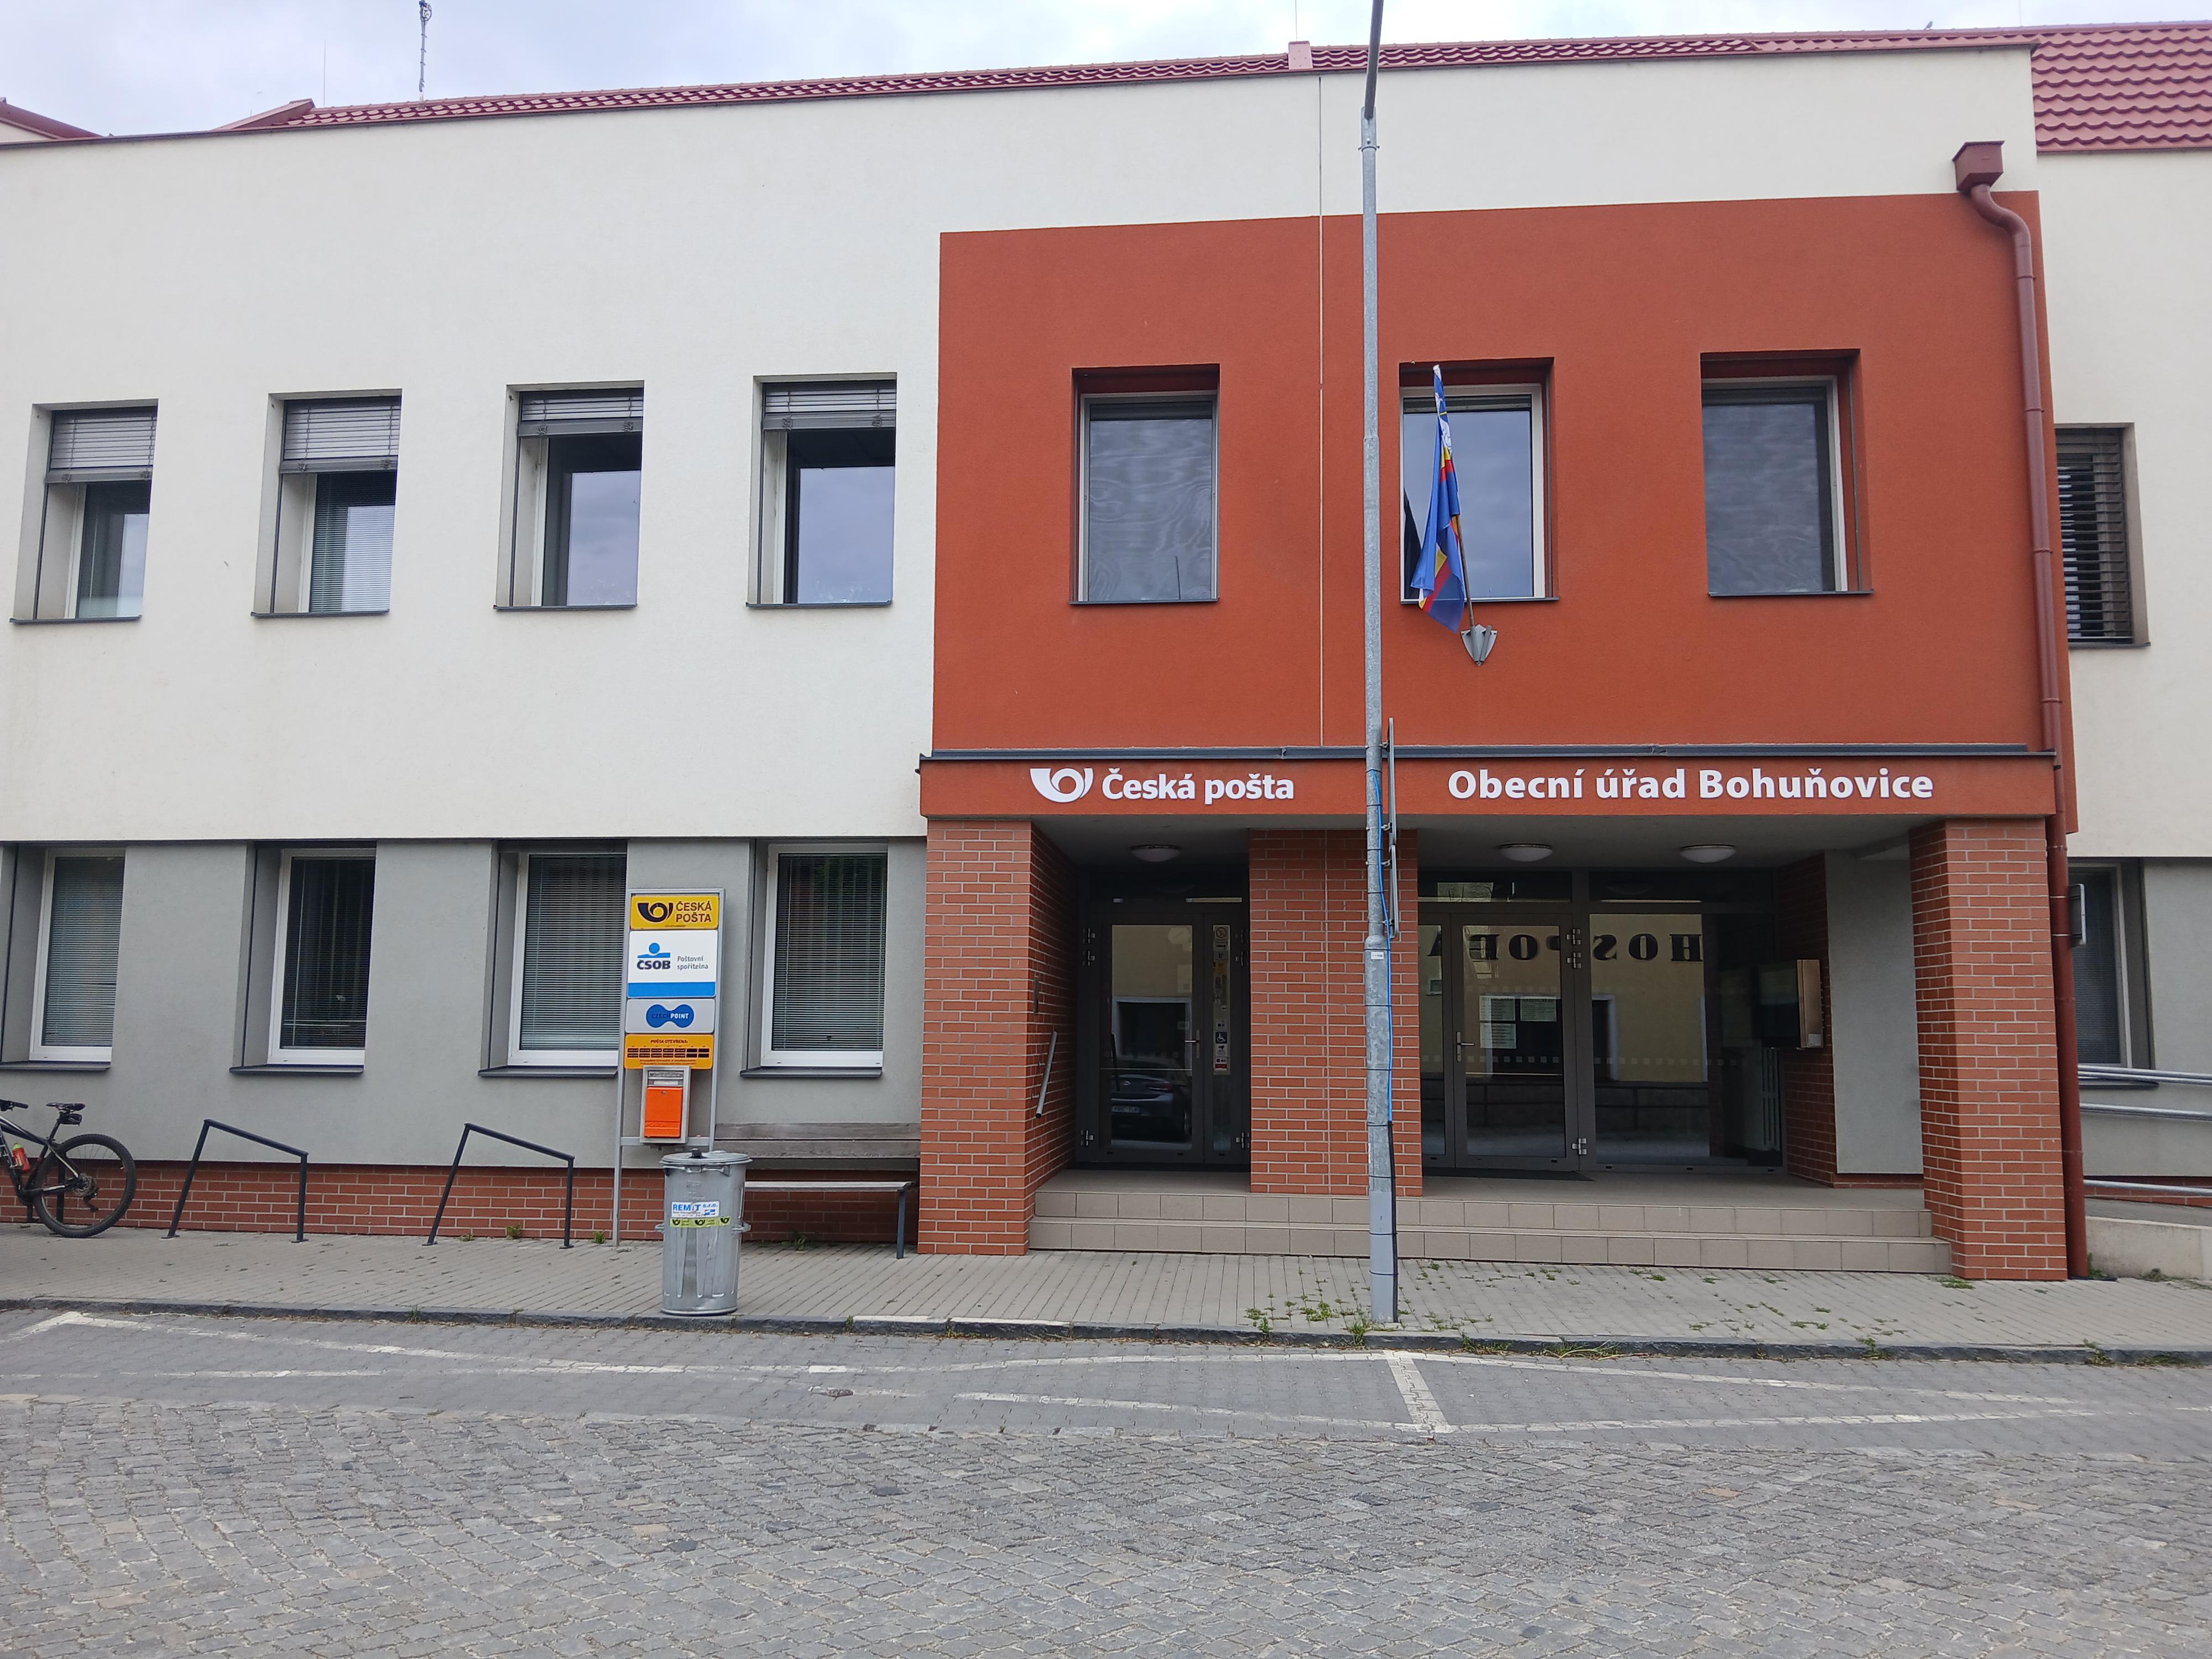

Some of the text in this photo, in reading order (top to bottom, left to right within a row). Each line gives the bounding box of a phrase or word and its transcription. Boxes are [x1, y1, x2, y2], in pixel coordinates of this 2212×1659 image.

[1102, 768, 1294, 805] Česká pošta
[1447, 767, 1934, 799] Obecní úřad Bohuňovice
[676, 900, 712, 911] ČESKÁ
[676, 912, 712, 923] POŠTA
[637, 959, 671, 970] ČSOB
